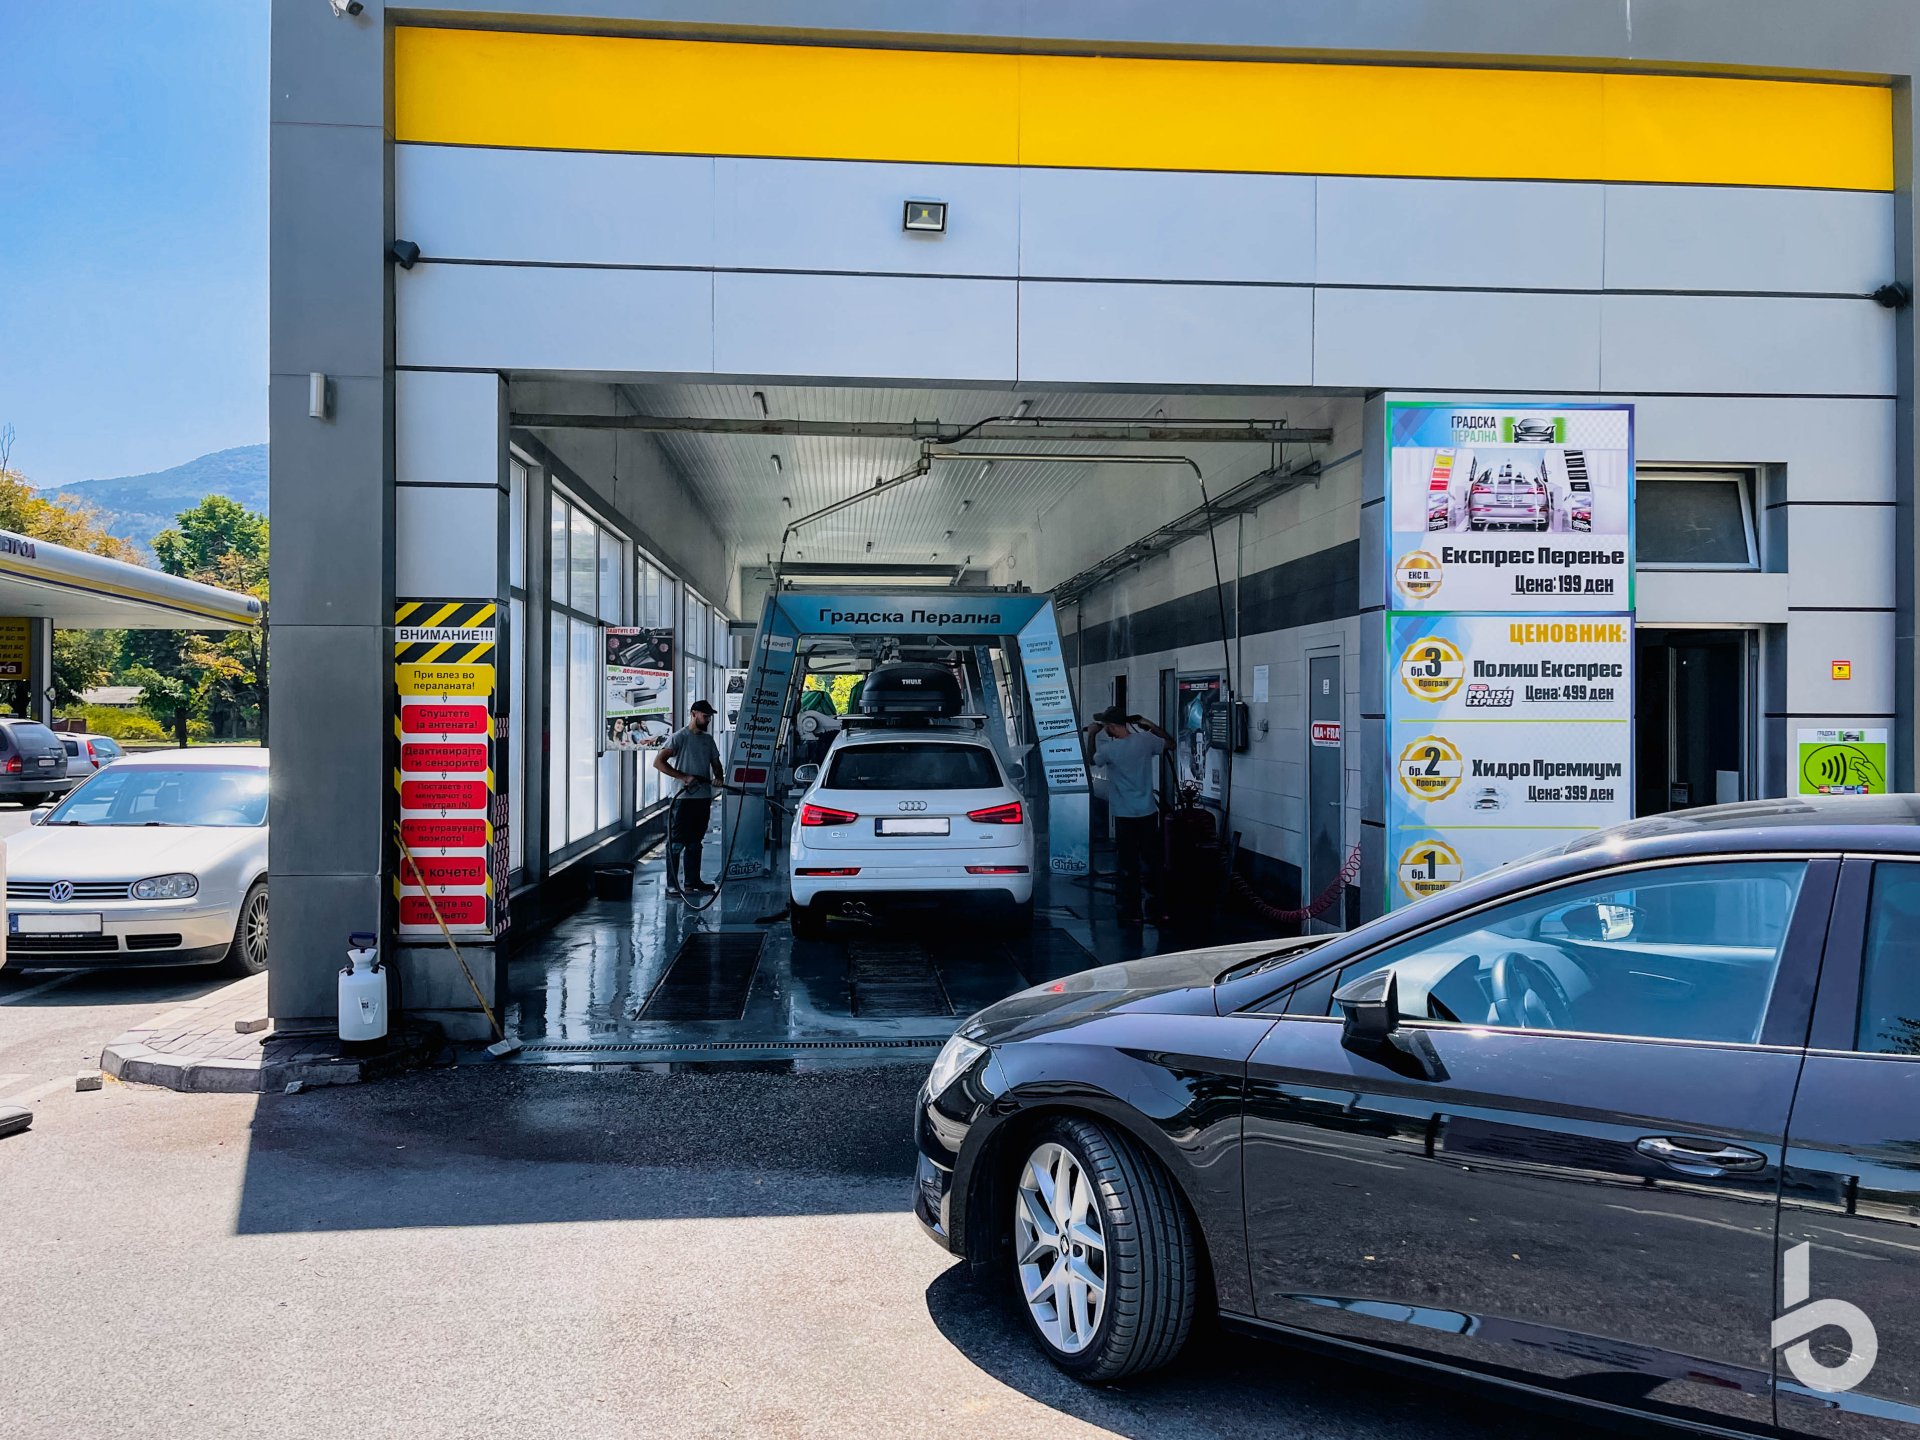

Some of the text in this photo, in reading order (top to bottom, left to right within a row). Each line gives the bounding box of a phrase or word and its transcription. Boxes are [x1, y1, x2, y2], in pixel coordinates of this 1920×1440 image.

[1451, 416, 1496, 430] ГРАДСКА
[1452, 430, 1498, 443] ПЕРАЛНА
[1442, 546, 1624, 568] Експрес Перење
[1408, 571, 1422, 580] ЕКС
[1515, 574, 1614, 594] Цена: 199 ден
[820, 608, 1001, 626] Градска Перална
[400, 629, 493, 641] ВНИМАНИЕ!!!
[1510, 623, 1627, 646] ЦЕНОВНИК:
[414, 671, 433, 680] При
[1473, 660, 1623, 681] Полиш Експрес
[414, 682, 475, 691] пераланата!
[1418, 679, 1449, 688] Програм
[1468, 690, 1513, 698] POLISH
[1525, 686, 1614, 702] Цена: 499 ден
[1466, 698, 1512, 706] EXPRESS
[419, 709, 470, 719] Спуштете
[428, 721, 478, 729] антената!
[1472, 759, 1622, 780] Хидро Премиум
[1416, 779, 1447, 788] Програм
[1528, 786, 1614, 802] Цена: 399 ден
[430, 866, 481, 877] кочете!
